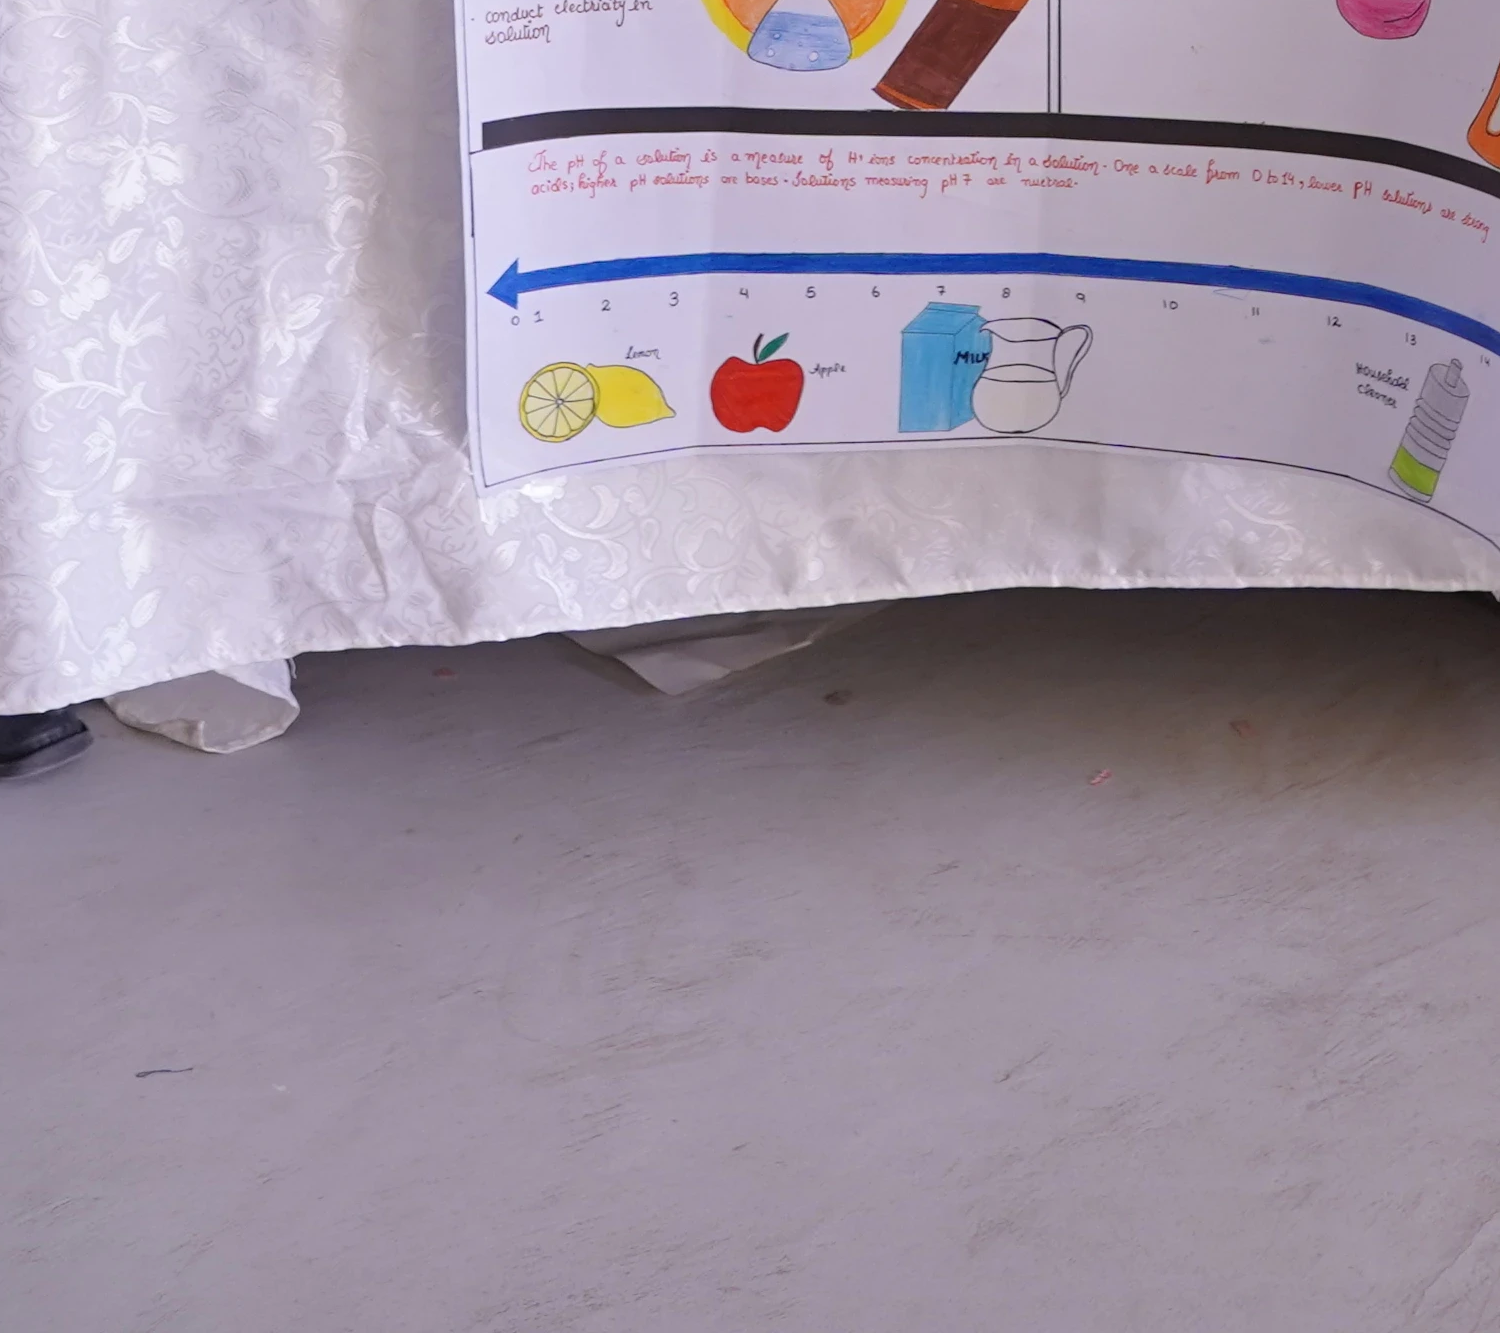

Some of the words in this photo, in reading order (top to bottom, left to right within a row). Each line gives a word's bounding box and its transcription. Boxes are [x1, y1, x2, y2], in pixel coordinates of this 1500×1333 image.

[484, 2, 545, 25] conduct
[484, 18, 552, 46] solution
[527, 148, 559, 174] The
[566, 153, 585, 176] pH
[592, 149, 608, 176] of
[614, 154, 627, 166] a
[699, 147, 718, 164] is
[730, 152, 742, 163] a
[744, 150, 804, 171] measure
[818, 147, 835, 172] of
[1028, 156, 1040, 167] a
[1148, 163, 1160, 176] a
[577, 172, 619, 200] higher
[628, 173, 647, 193] pH
[940, 172, 958, 196] pH
[533, 310, 545, 324] 1
[600, 299, 612, 312] 2
[668, 291, 680, 308] 3
[738, 287, 750, 300] 4
[805, 286, 817, 299] 5
[871, 286, 881, 299] 6
[935, 285, 947, 296] 7
[1001, 287, 1012, 299] 8
[1075, 292, 1087, 304] 9
[1162, 299, 1179, 311] 10
[1326, 315, 1343, 328] 12
[1404, 332, 1418, 347] 13
[624, 345, 663, 361] Lemon
[808, 363, 848, 380] Apple
